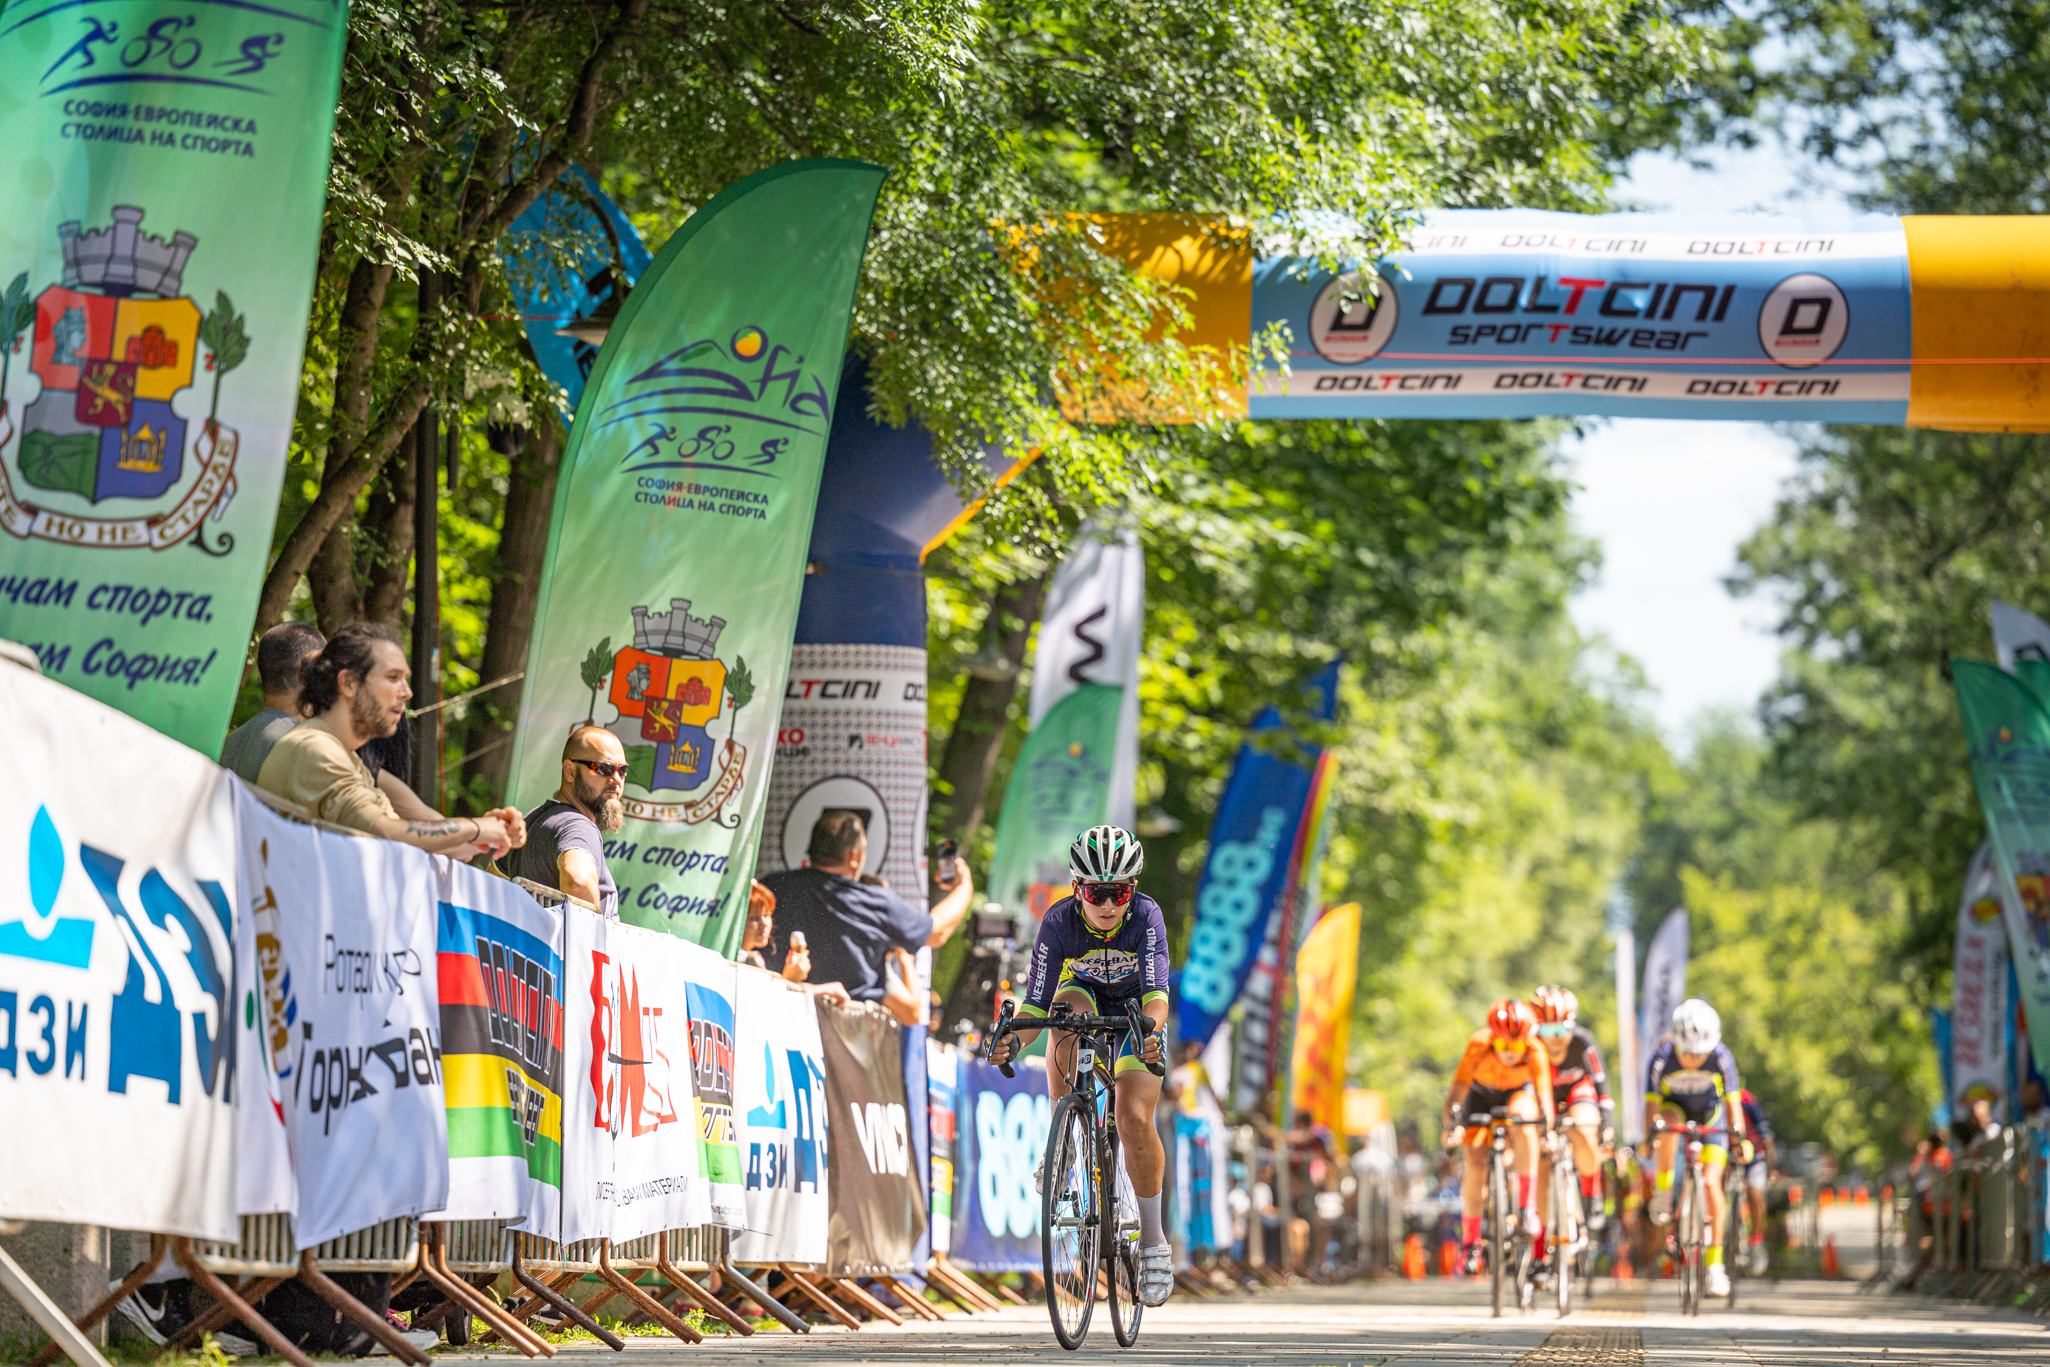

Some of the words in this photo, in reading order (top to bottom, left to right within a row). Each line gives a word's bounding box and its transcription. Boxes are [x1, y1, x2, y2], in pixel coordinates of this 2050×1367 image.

[60, 121, 146, 146] СТОЛИЦА
[150, 129, 177, 148] НА
[180, 132, 256, 159] СПОРТА
[1501, 234, 1647, 253] DOLTCINI
[1687, 239, 1834, 255] DOLTCINI
[1421, 276, 1737, 323] DOLTCINI
[1779, 296, 1833, 335] D
[1313, 374, 1463, 391] DOLTCINI
[1492, 372, 1649, 394] DOLTCINI
[1685, 378, 1842, 397] DOLTCINI
[634, 490, 695, 510] СТОЛИЦА
[697, 500, 715, 512] НА
[719, 503, 767, 520] СПОРТА
[44, 515, 85, 539] НО
[97, 523, 143, 543] НЕ
[82, 636, 217, 691] София!
[651, 806, 682, 818] НЕ
[637, 882, 731, 919] София!
[746, 1142, 788, 1191] ДЗИ
